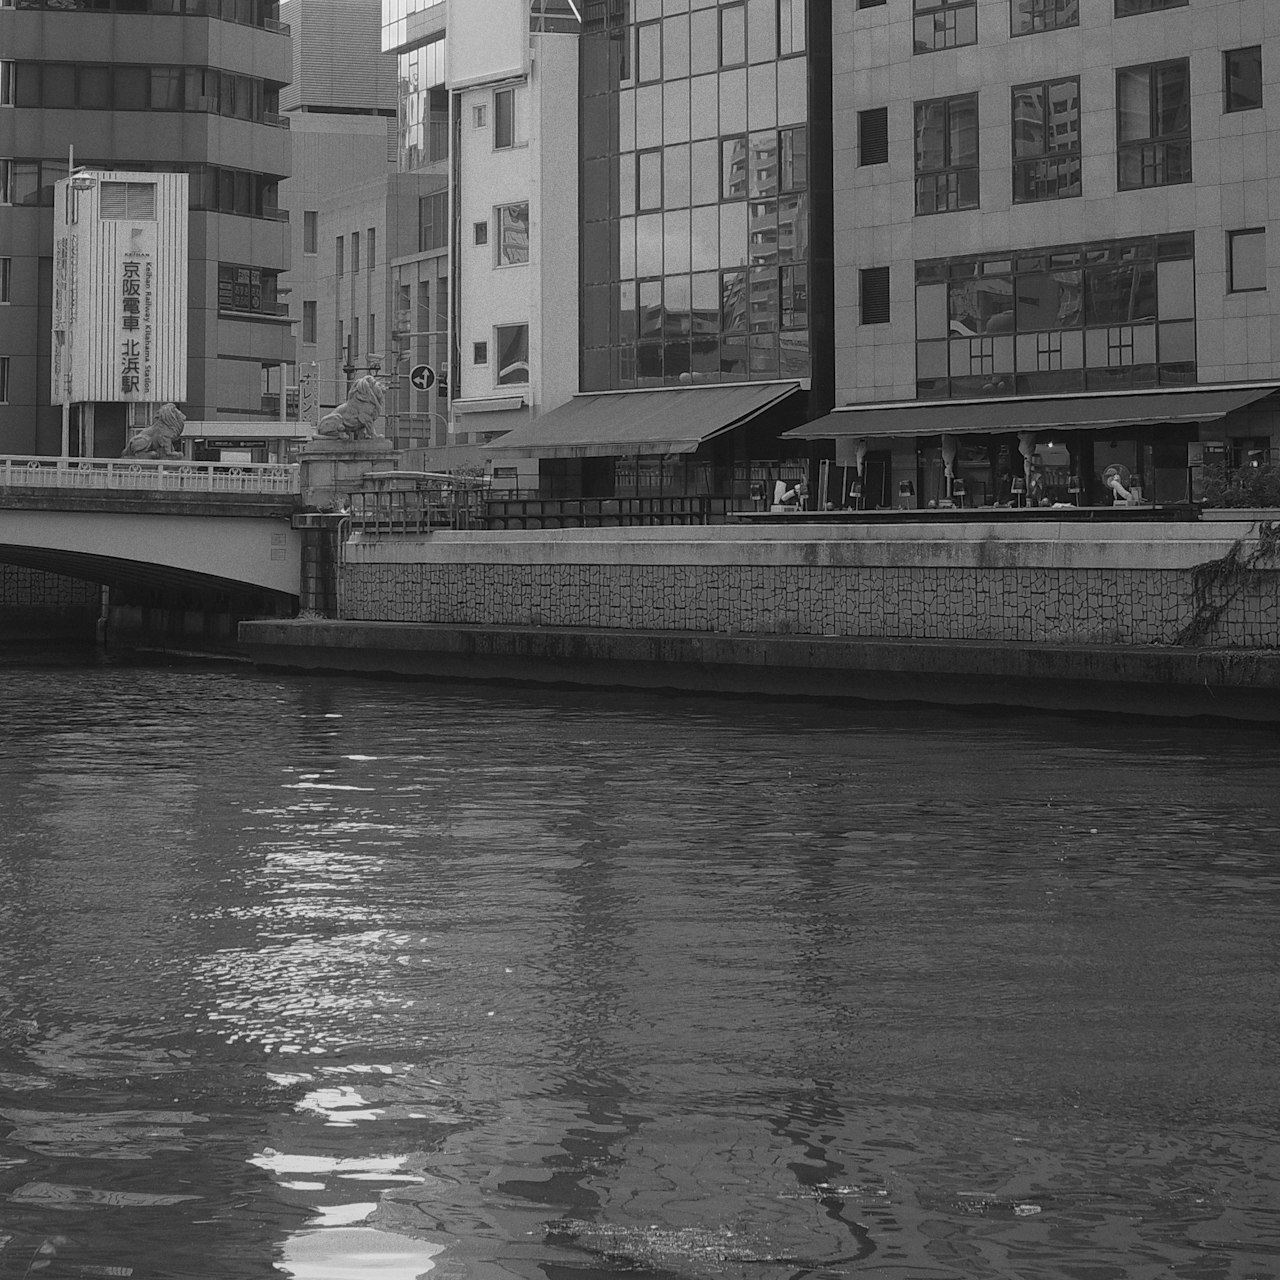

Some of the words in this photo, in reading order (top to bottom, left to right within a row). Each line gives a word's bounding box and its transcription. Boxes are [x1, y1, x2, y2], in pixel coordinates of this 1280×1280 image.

[122, 261, 141, 332] 京阪電車
[143, 291, 152, 322] Railway
[144, 324, 152, 362] Kitahama
[121, 339, 140, 394] 北浜駅
